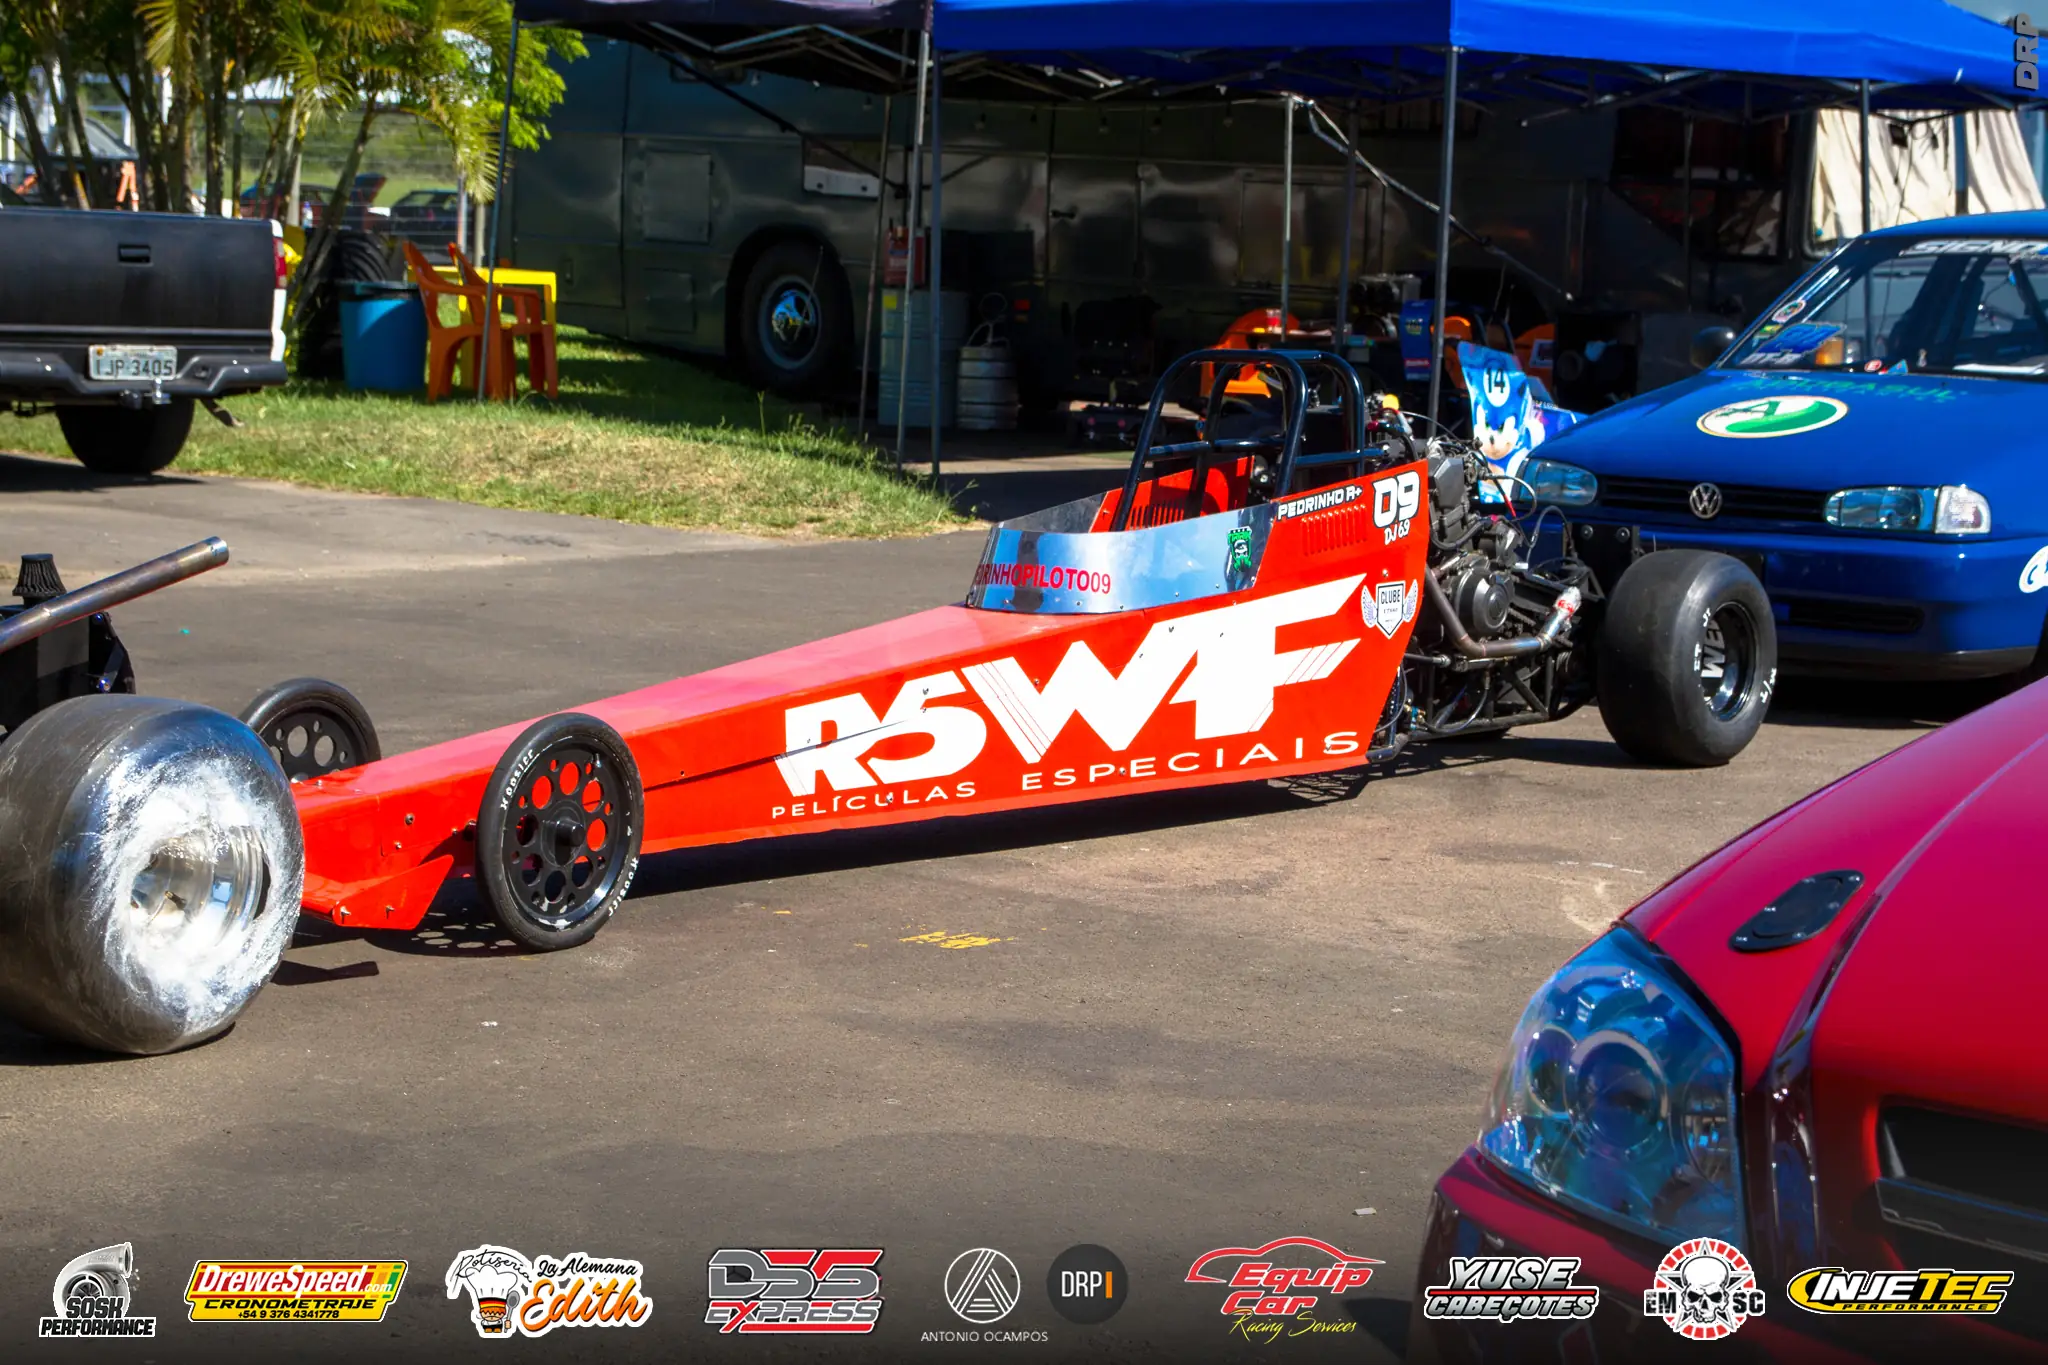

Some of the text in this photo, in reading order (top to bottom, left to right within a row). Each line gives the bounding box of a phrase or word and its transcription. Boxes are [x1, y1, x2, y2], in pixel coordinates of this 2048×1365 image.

[1485, 367, 1506, 393] 14
[1277, 488, 1344, 521] PEDRINHO
[1372, 470, 1420, 528] 09
[1381, 589, 1401, 604] CLUBE
[772, 731, 1359, 819] PELÍCULAS ESPECIAIS
